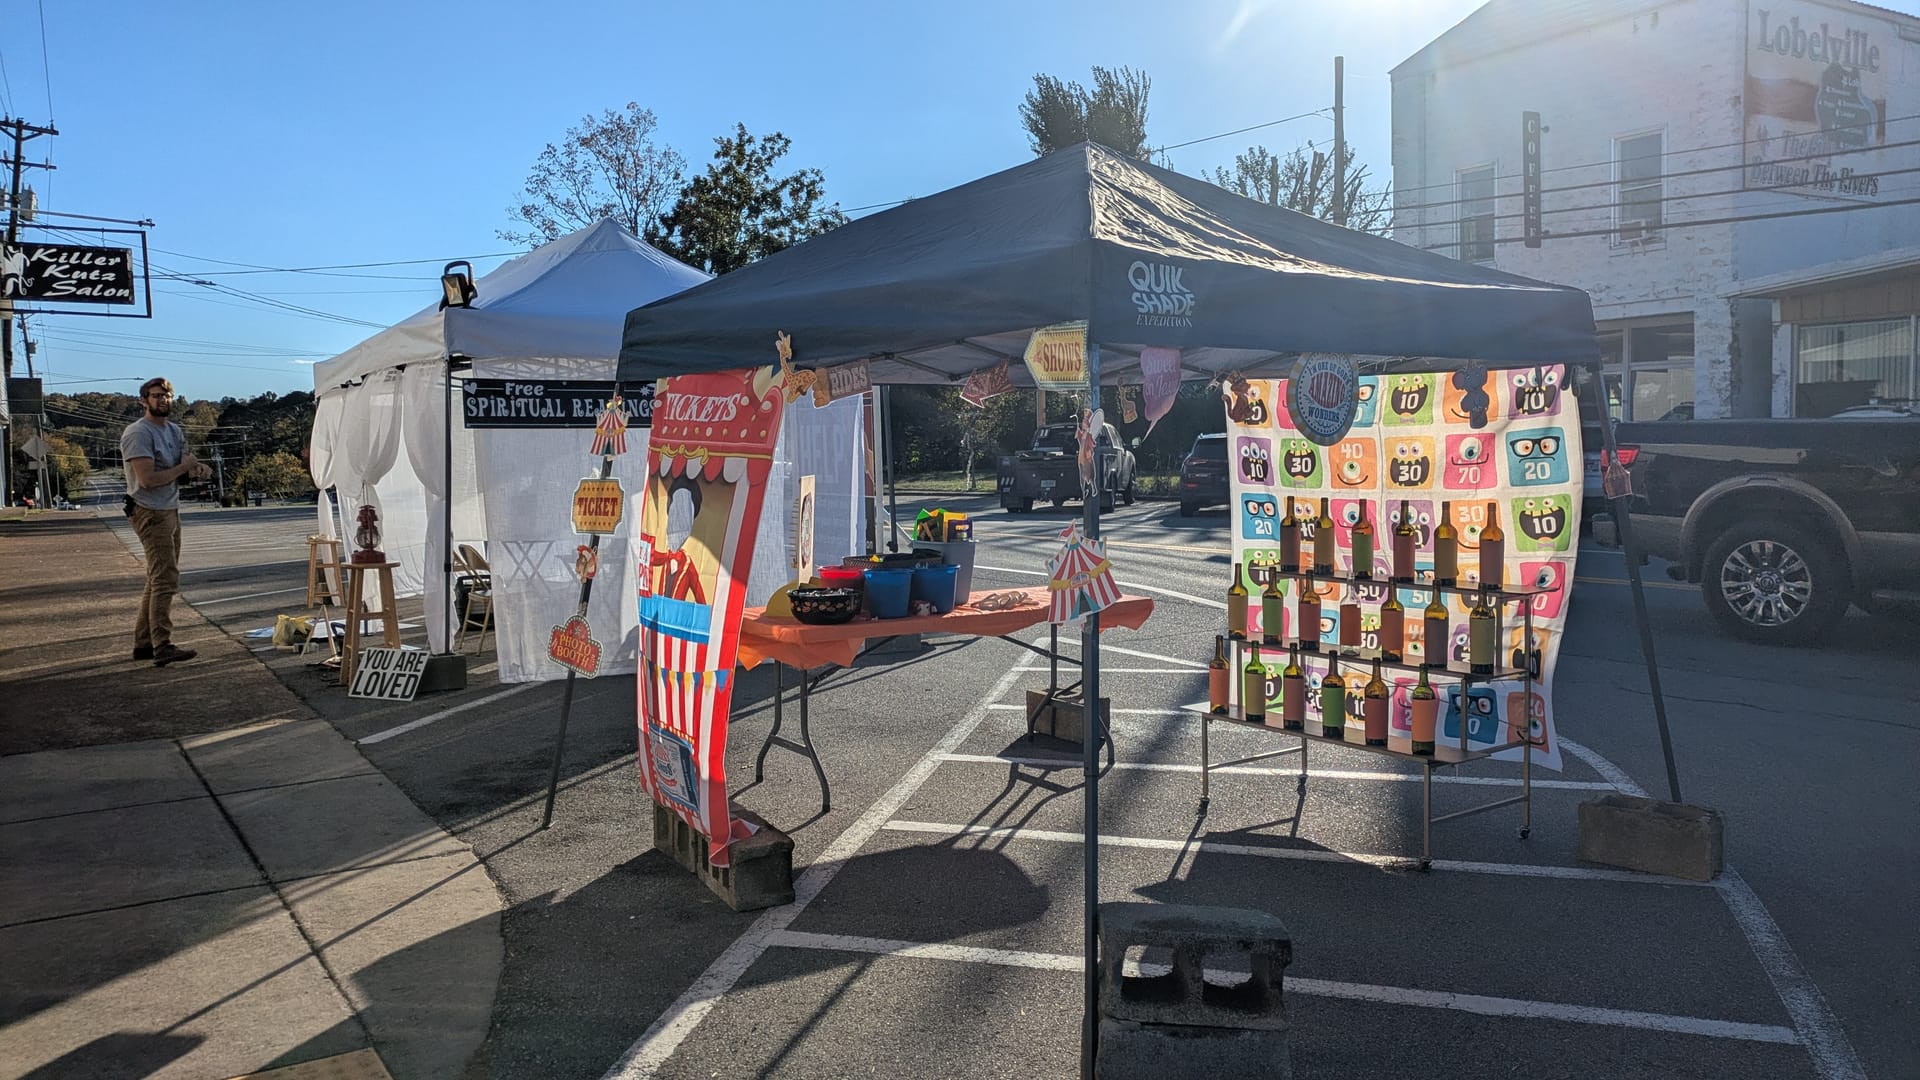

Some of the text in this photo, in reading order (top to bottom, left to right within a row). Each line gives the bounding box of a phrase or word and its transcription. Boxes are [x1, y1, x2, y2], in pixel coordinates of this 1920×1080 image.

[1757, 9, 1880, 73] Lobelville
[1751, 155, 1879, 197] Between The Rivers
[30, 247, 121, 266] Killer
[42, 264, 117, 281] Kutz
[1128, 261, 1191, 293] QUIK
[42, 280, 130, 297] Salon
[1131, 292, 1195, 316] SHADE
[1136, 314, 1193, 328] EXPEDITION
[1043, 341, 1081, 373] SHOWS
[505, 383, 544, 396] Free
[830, 365, 868, 397] RIDES
[664, 392, 741, 422] TICKETS
[1399, 392, 1420, 410] 10
[1523, 391, 1545, 410] 10
[1308, 406, 1340, 423] WONDERS
[1341, 443, 1363, 459] 40
[1250, 463, 1264, 479] 10
[1291, 457, 1312, 473] 30
[1398, 464, 1422, 482] 30
[1524, 461, 1551, 480] 20
[1458, 466, 1481, 484] 70
[576, 496, 619, 517] TICKET
[1459, 505, 1485, 523] 30
[1254, 519, 1273, 535] 20
[1532, 516, 1557, 534] 10
[560, 633, 592, 657] PHOTO
[364, 649, 428, 673] YOU ARE
[557, 645, 589, 668] BOOTH
[351, 670, 419, 698] LOVED
